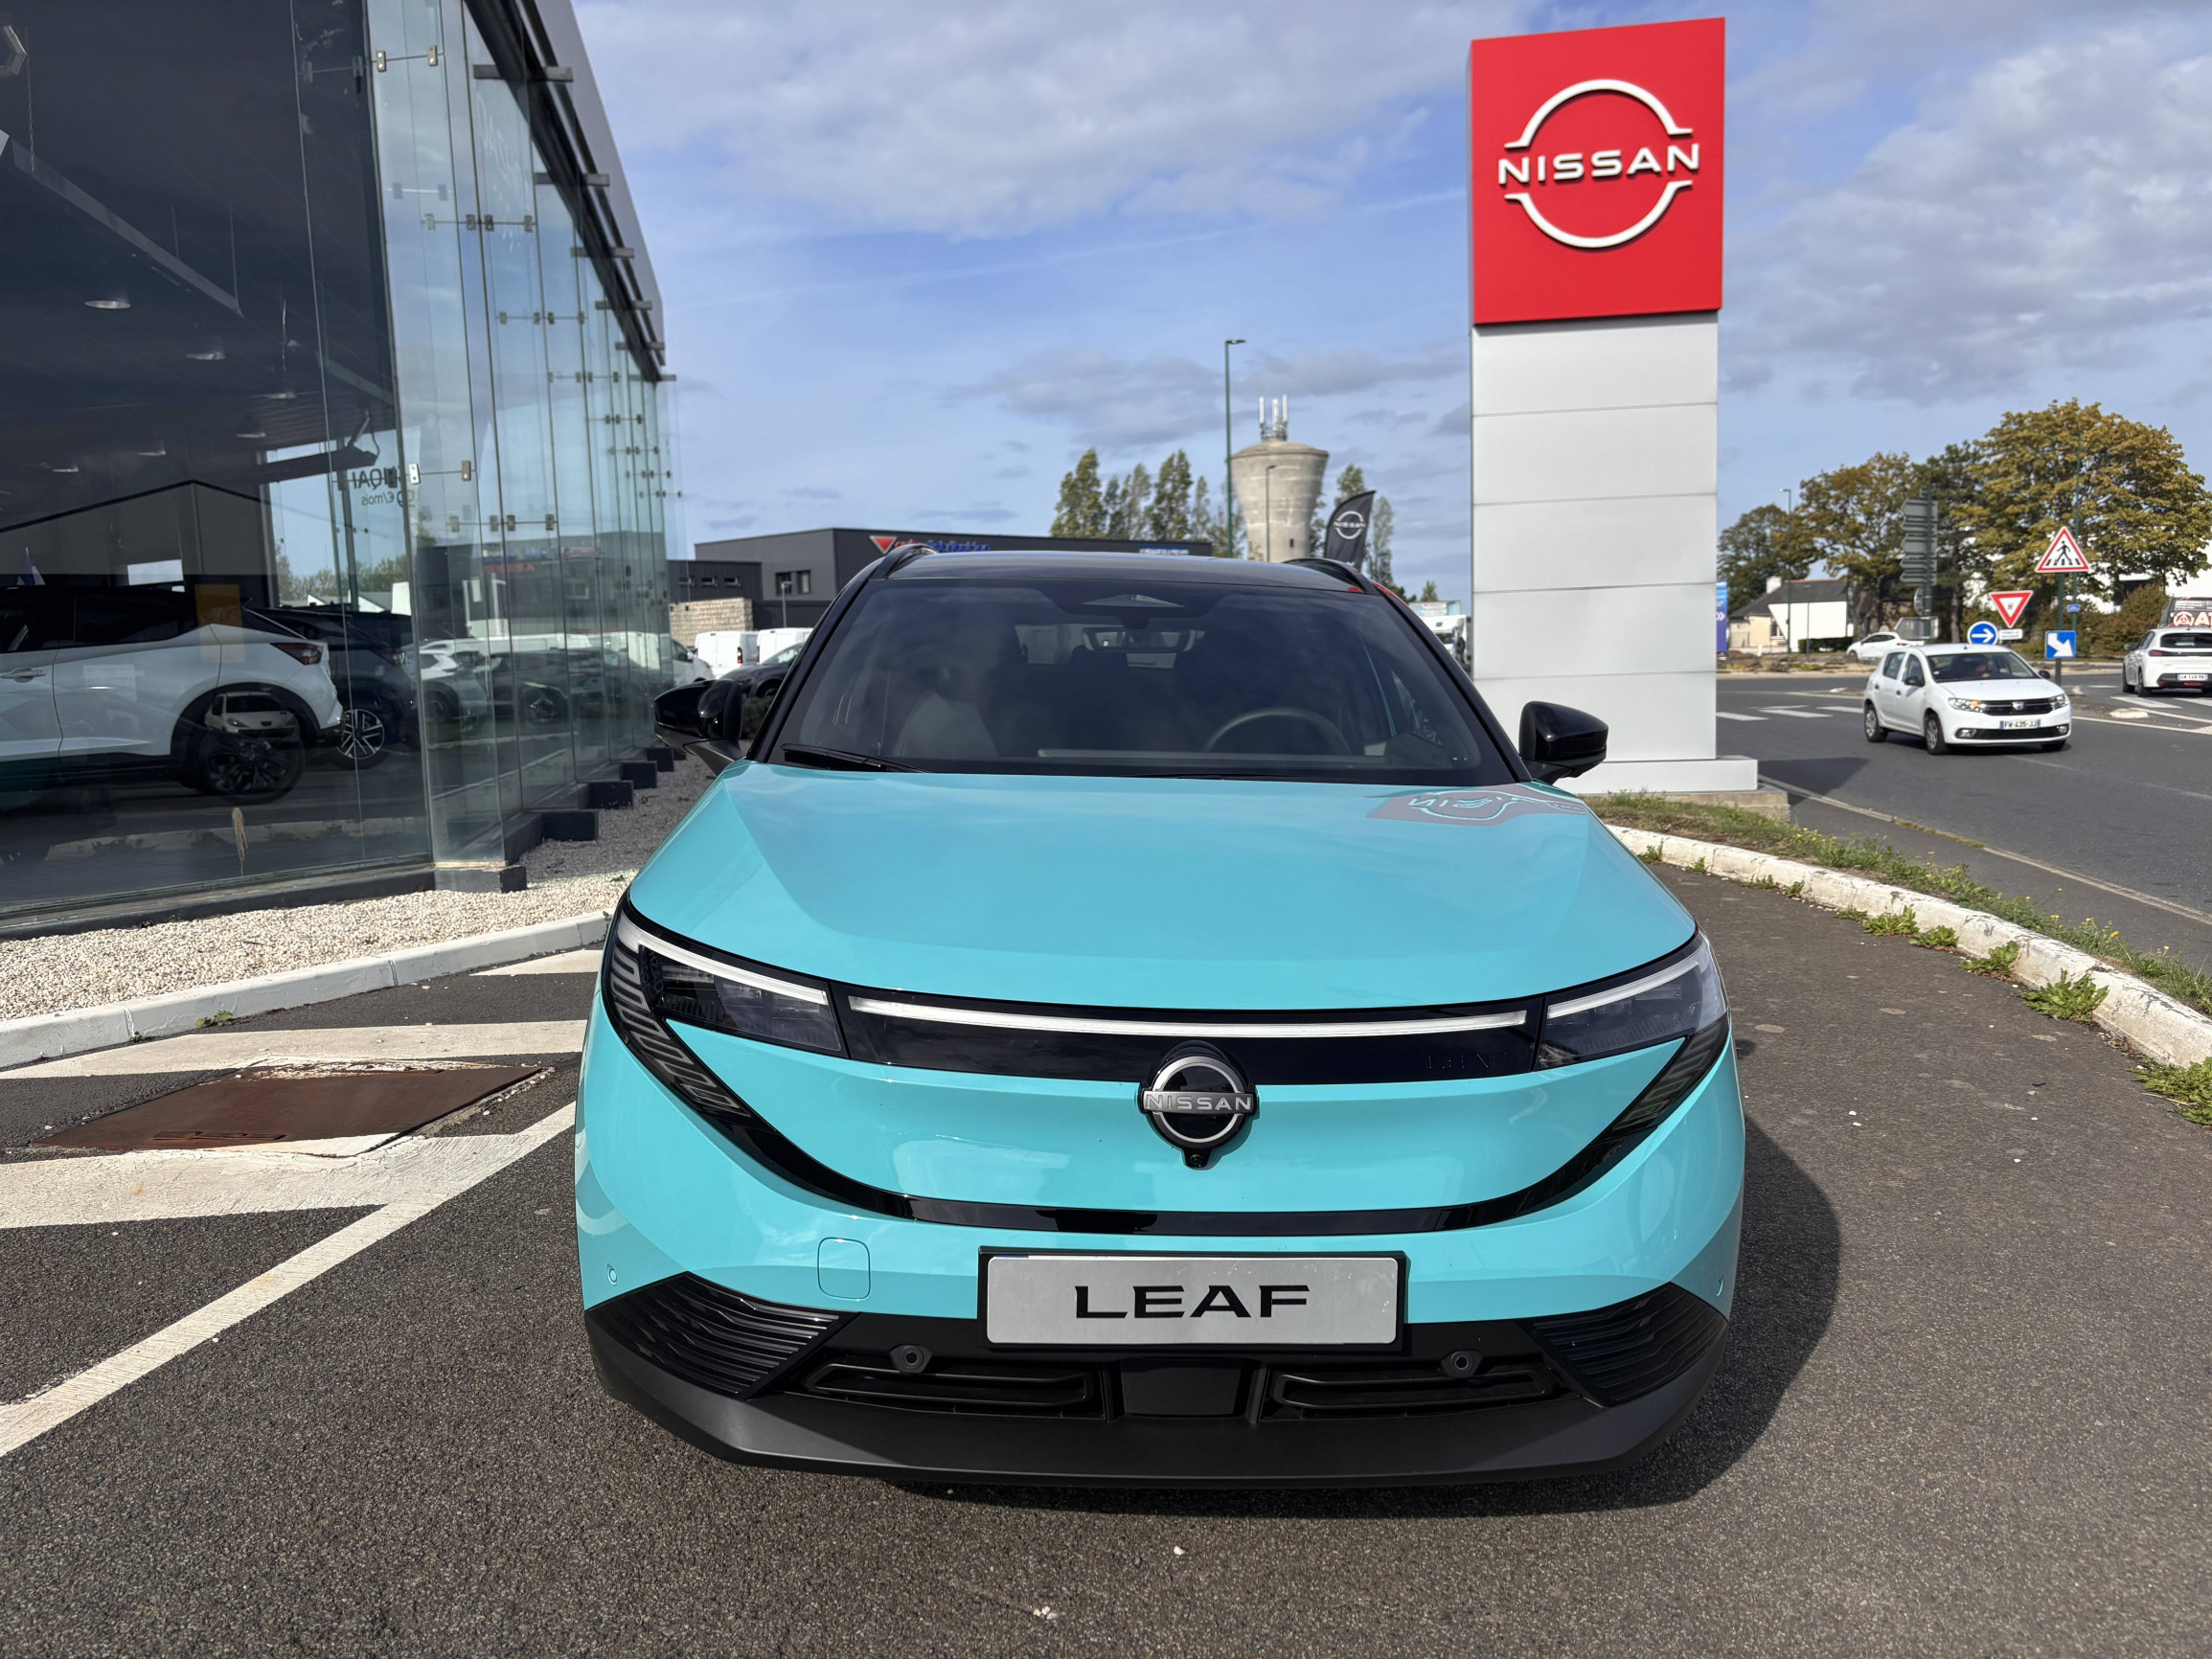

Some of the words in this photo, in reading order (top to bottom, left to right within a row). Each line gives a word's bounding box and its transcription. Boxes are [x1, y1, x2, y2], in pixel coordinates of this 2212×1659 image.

[1498, 144, 1699, 185] NISSAN
[1146, 1094, 1252, 1111] NISSAN
[1074, 1284, 1310, 1319] LEAF
